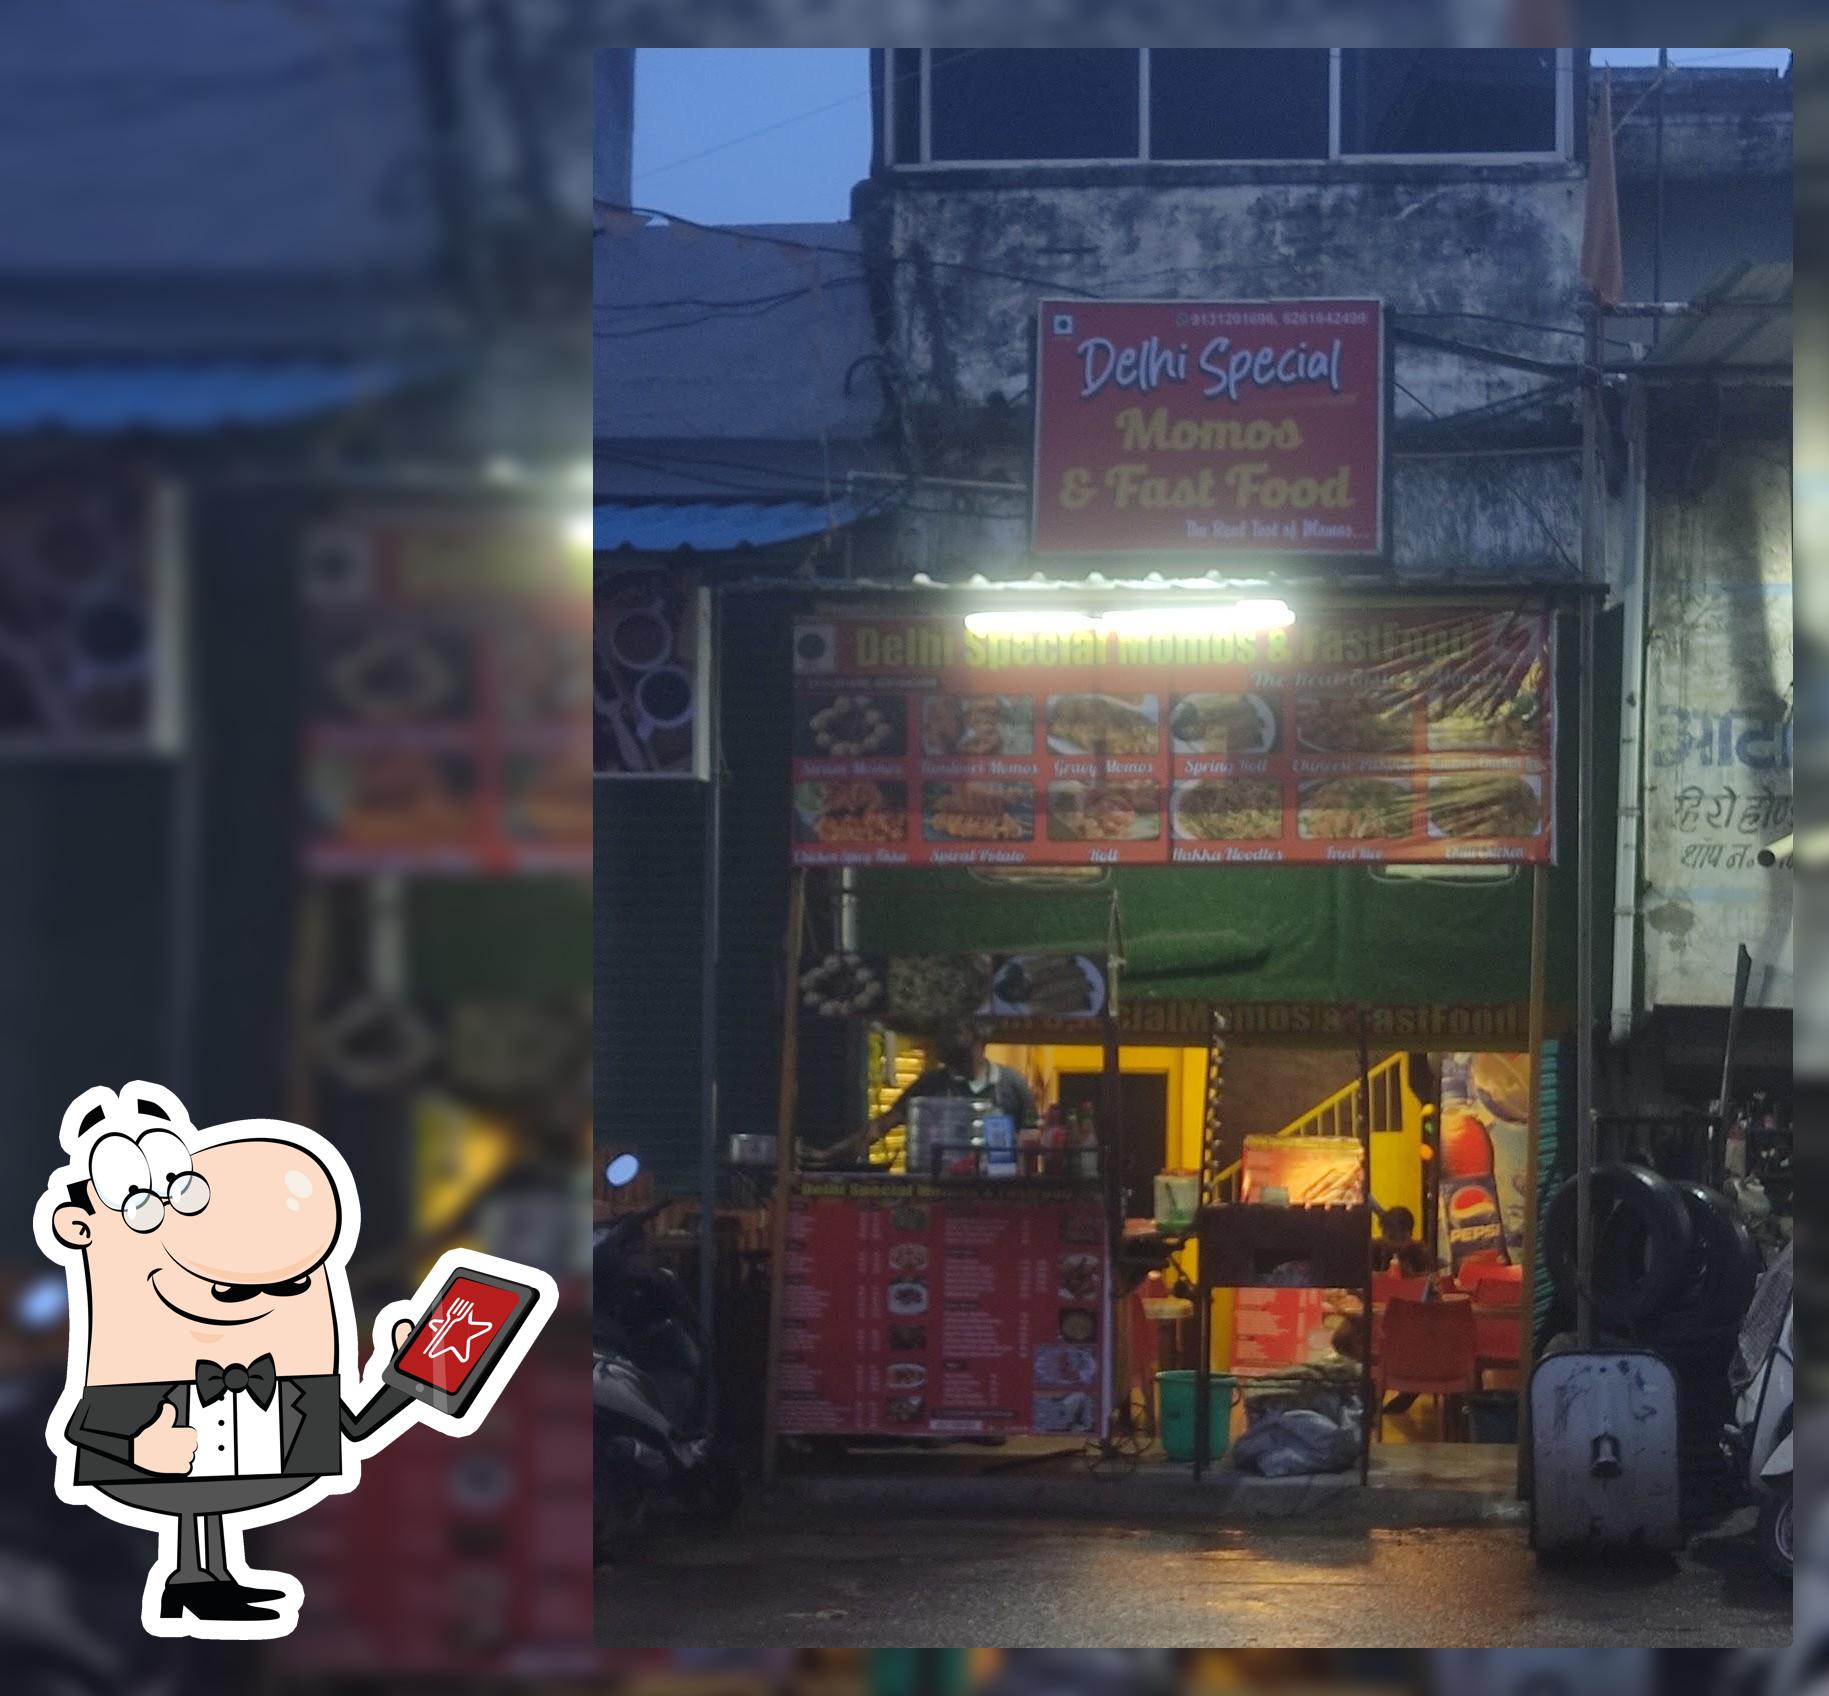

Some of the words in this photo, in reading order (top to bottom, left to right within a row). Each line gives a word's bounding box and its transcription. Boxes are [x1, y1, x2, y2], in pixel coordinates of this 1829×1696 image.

[1078, 336, 1188, 399] Delhi
[1200, 336, 1343, 400] Special
[1114, 406, 1304, 451] Momos
[1059, 467, 1099, 510] &
[1105, 464, 1216, 510] Fast
[1225, 463, 1356, 509] Food
[856, 625, 955, 667] Delhi
[964, 627, 1108, 670] Special
[1267, 626, 1290, 663] &
[990, 759, 1039, 774] Momos
[1054, 759, 1098, 777] Gravy
[1106, 759, 1154, 774] Momos
[1184, 759, 1233, 776] Spring
[1089, 848, 1120, 863] Roll
[1172, 847, 1222, 861] Hakka
[1225, 846, 1284, 862] Noodles
